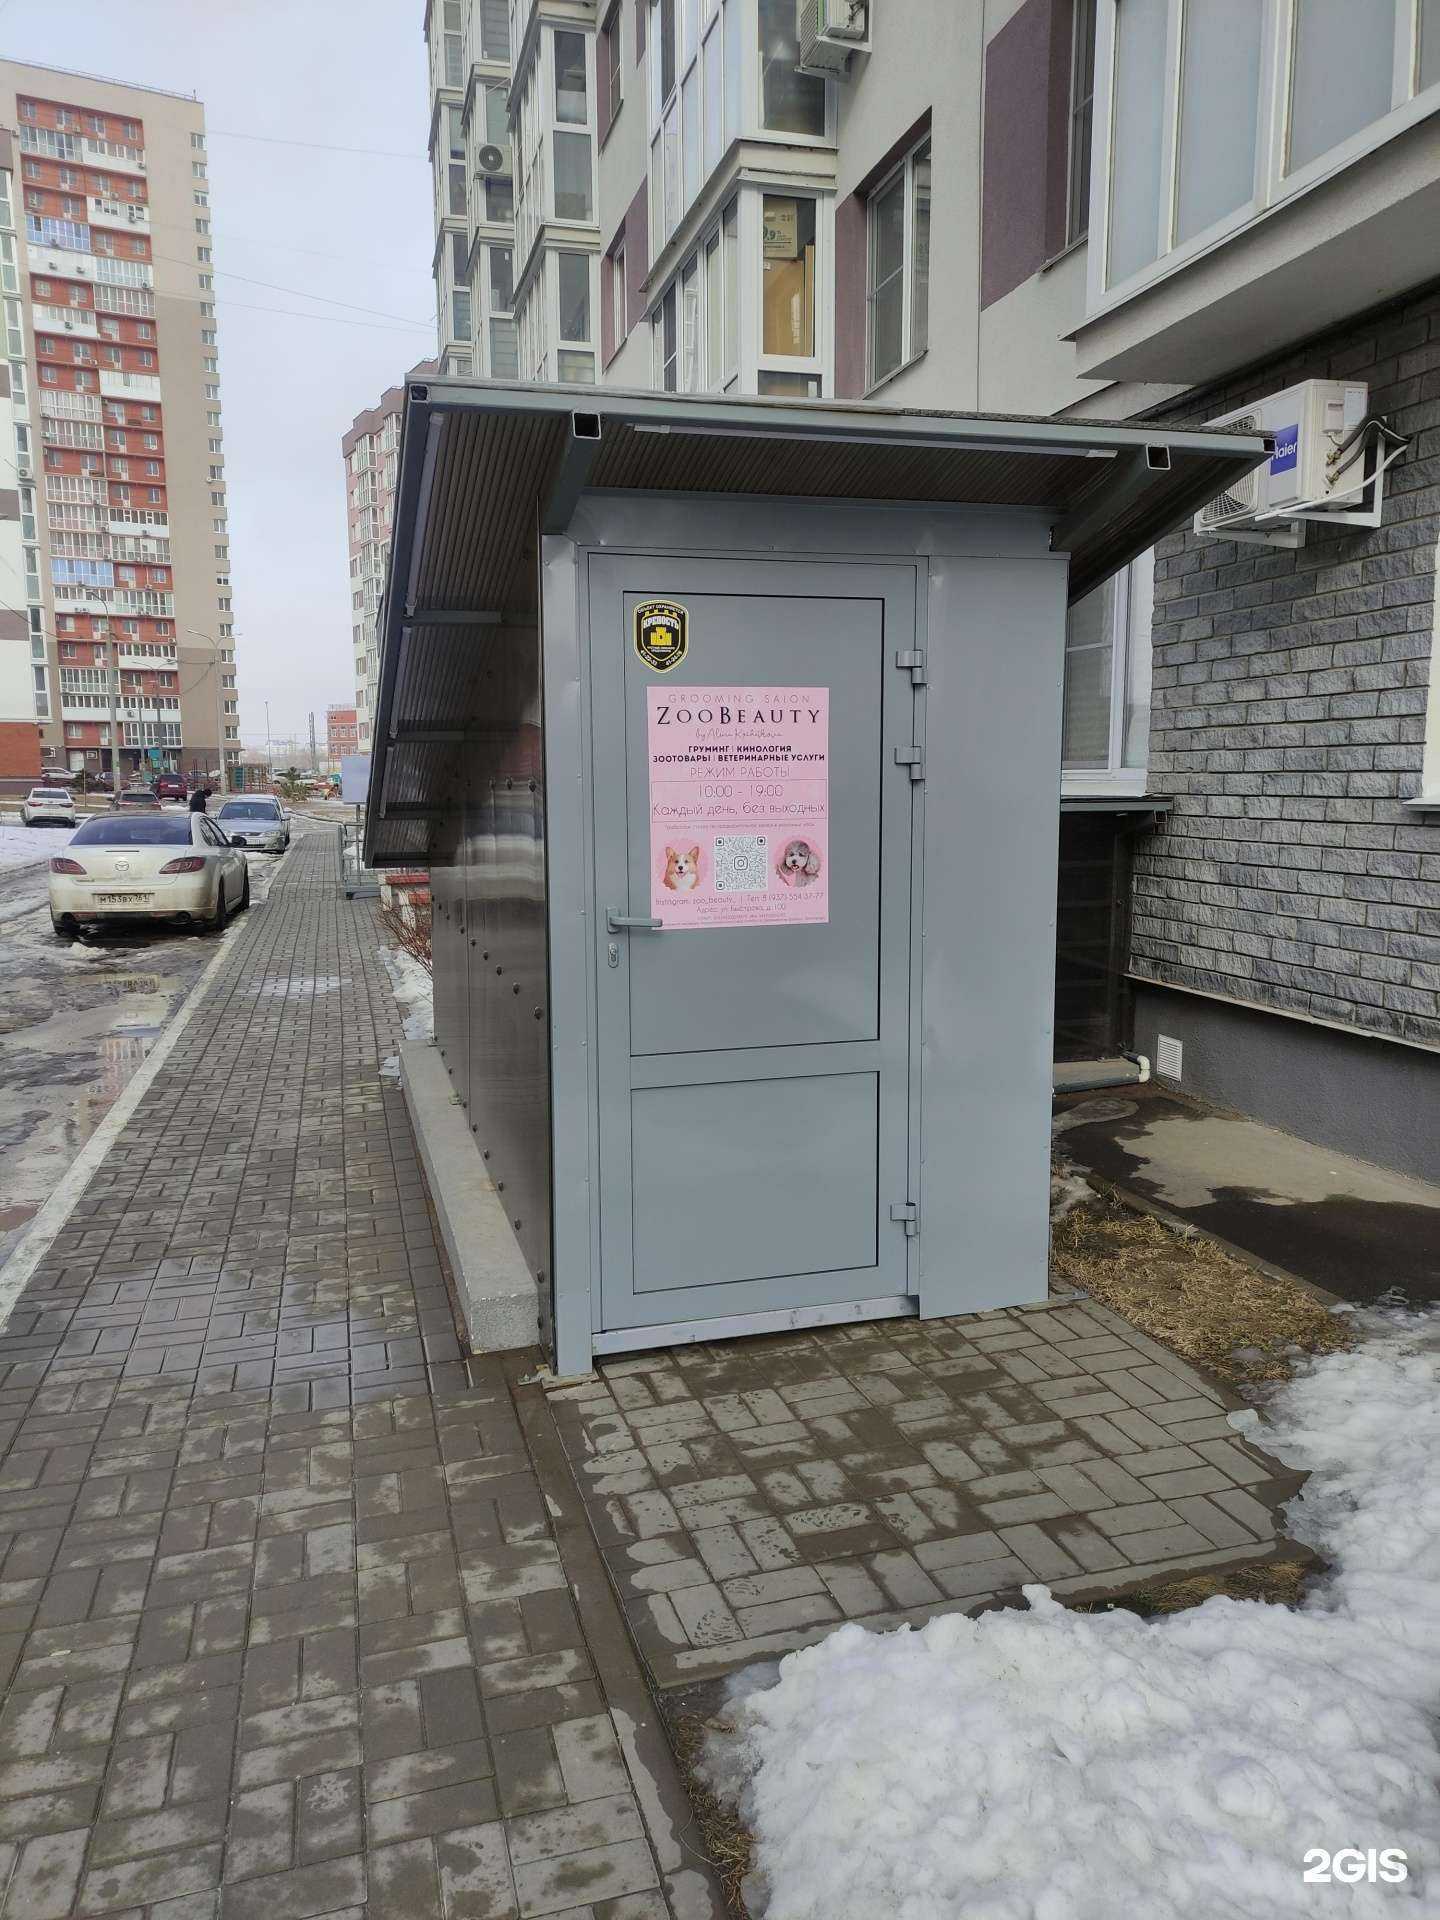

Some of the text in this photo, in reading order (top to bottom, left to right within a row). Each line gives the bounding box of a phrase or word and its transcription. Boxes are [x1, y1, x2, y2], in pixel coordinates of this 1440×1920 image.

[1271, 442, 1297, 460] Haier
[643, 615, 679, 630] КРЕПОСТЬ
[668, 694, 810, 704] GROOMING SALON
[688, 745, 792, 753] ГРУМИНГ КИНОЛОГИЯ
[653, 753, 825, 763] ЗООТОВАРЫ ВЕТЕРИНАРНЫЕ УСЛУГИ
[690, 766, 790, 778] РЕЖИМ РАБОТЫ
[699, 784, 733, 797] 10:00
[750, 784, 784, 797] 19:00
[653, 801, 825, 817] Каждый день, без выходных
